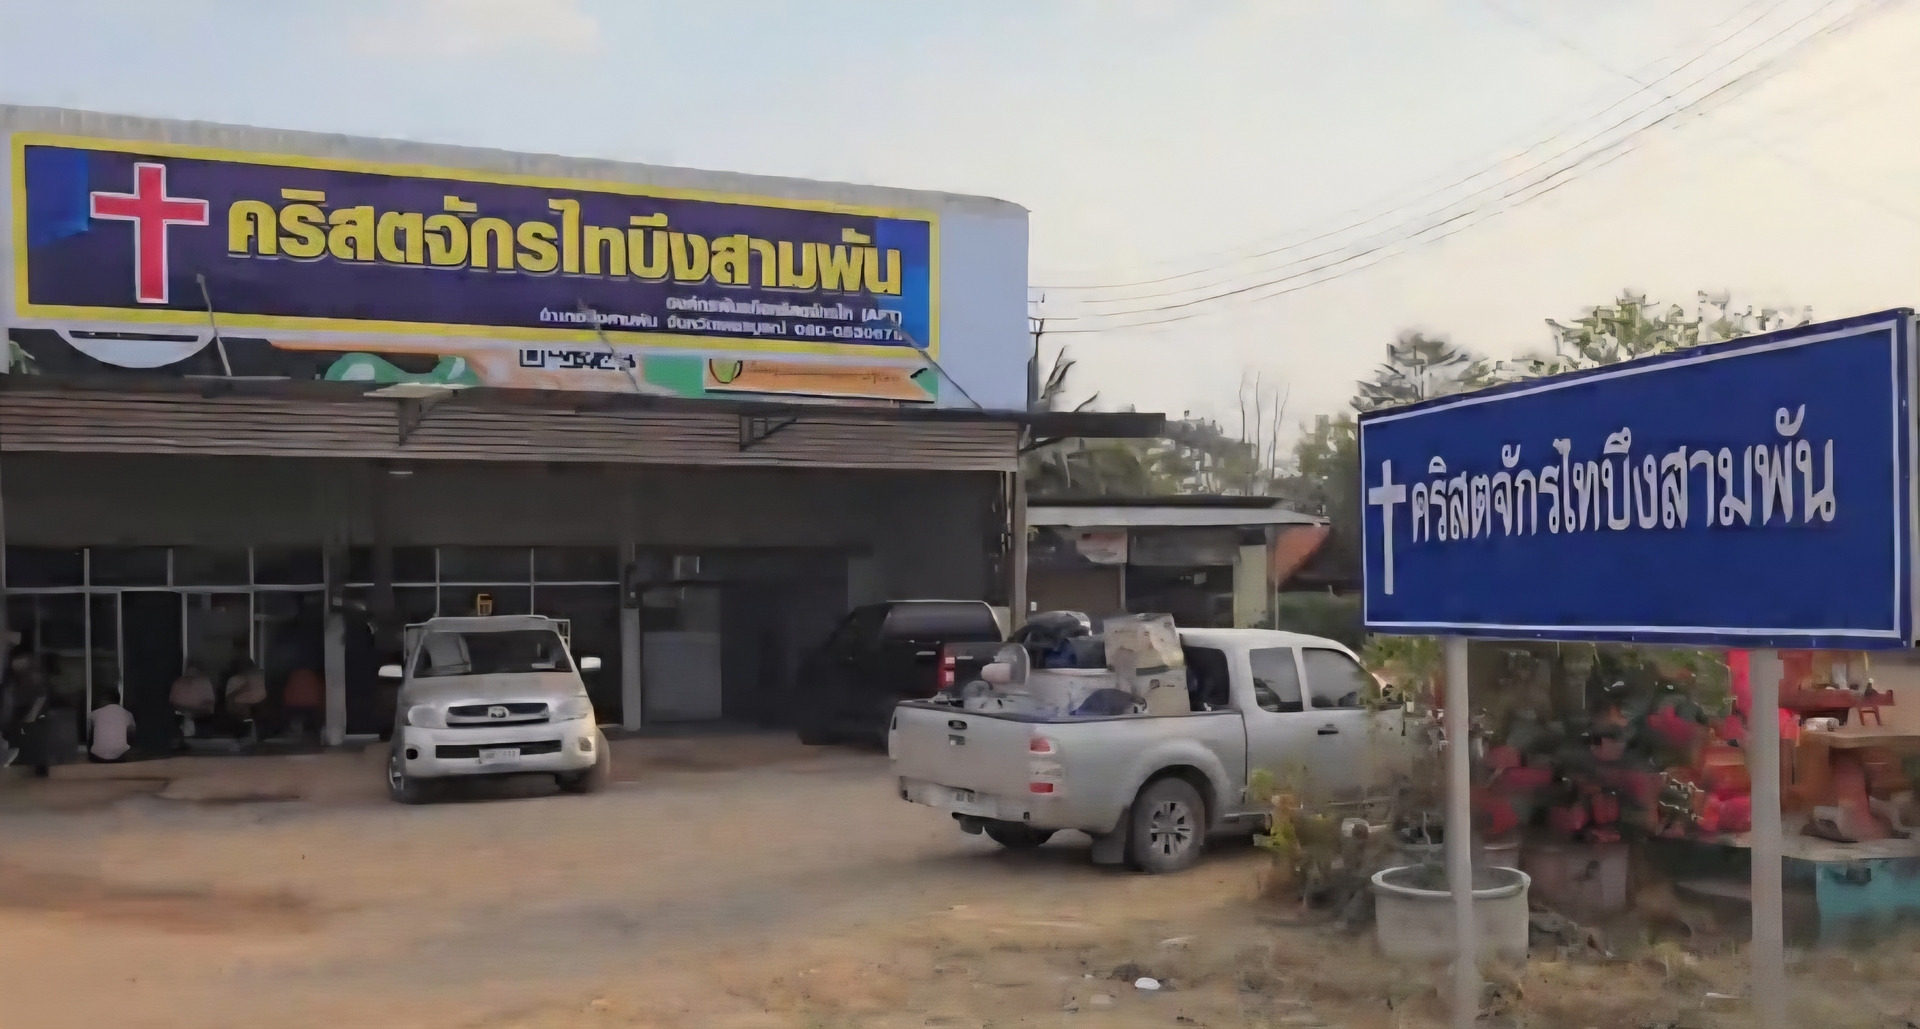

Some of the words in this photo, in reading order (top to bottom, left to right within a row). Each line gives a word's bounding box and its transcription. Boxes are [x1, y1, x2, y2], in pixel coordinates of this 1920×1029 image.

[228, 188, 902, 296] คริสตจักรไทบึงสามพัน
[1411, 404, 1837, 543] คริสตจักรไทบึงสามพัน
